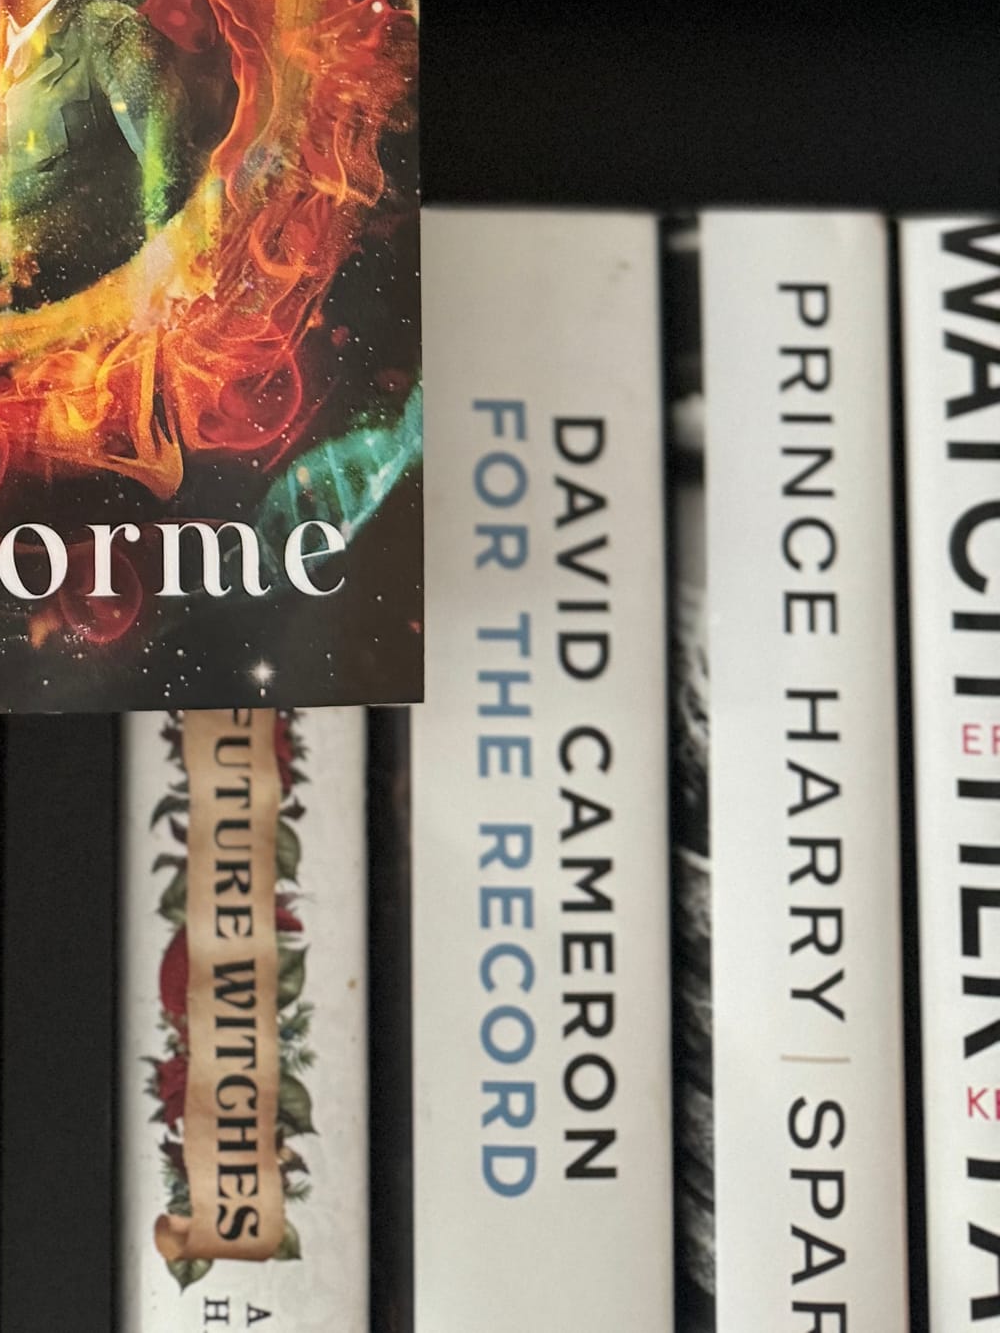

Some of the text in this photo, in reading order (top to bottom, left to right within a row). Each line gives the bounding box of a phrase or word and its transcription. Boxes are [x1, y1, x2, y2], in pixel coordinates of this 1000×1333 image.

[777, 282, 838, 635] PRINCE
[471, 399, 537, 1198] FOR THE RECORD
[552, 416, 618, 1179] DAVID CAMERON
[785, 688, 845, 1021] HARRY
[212, 963, 259, 1241] WITCHES
